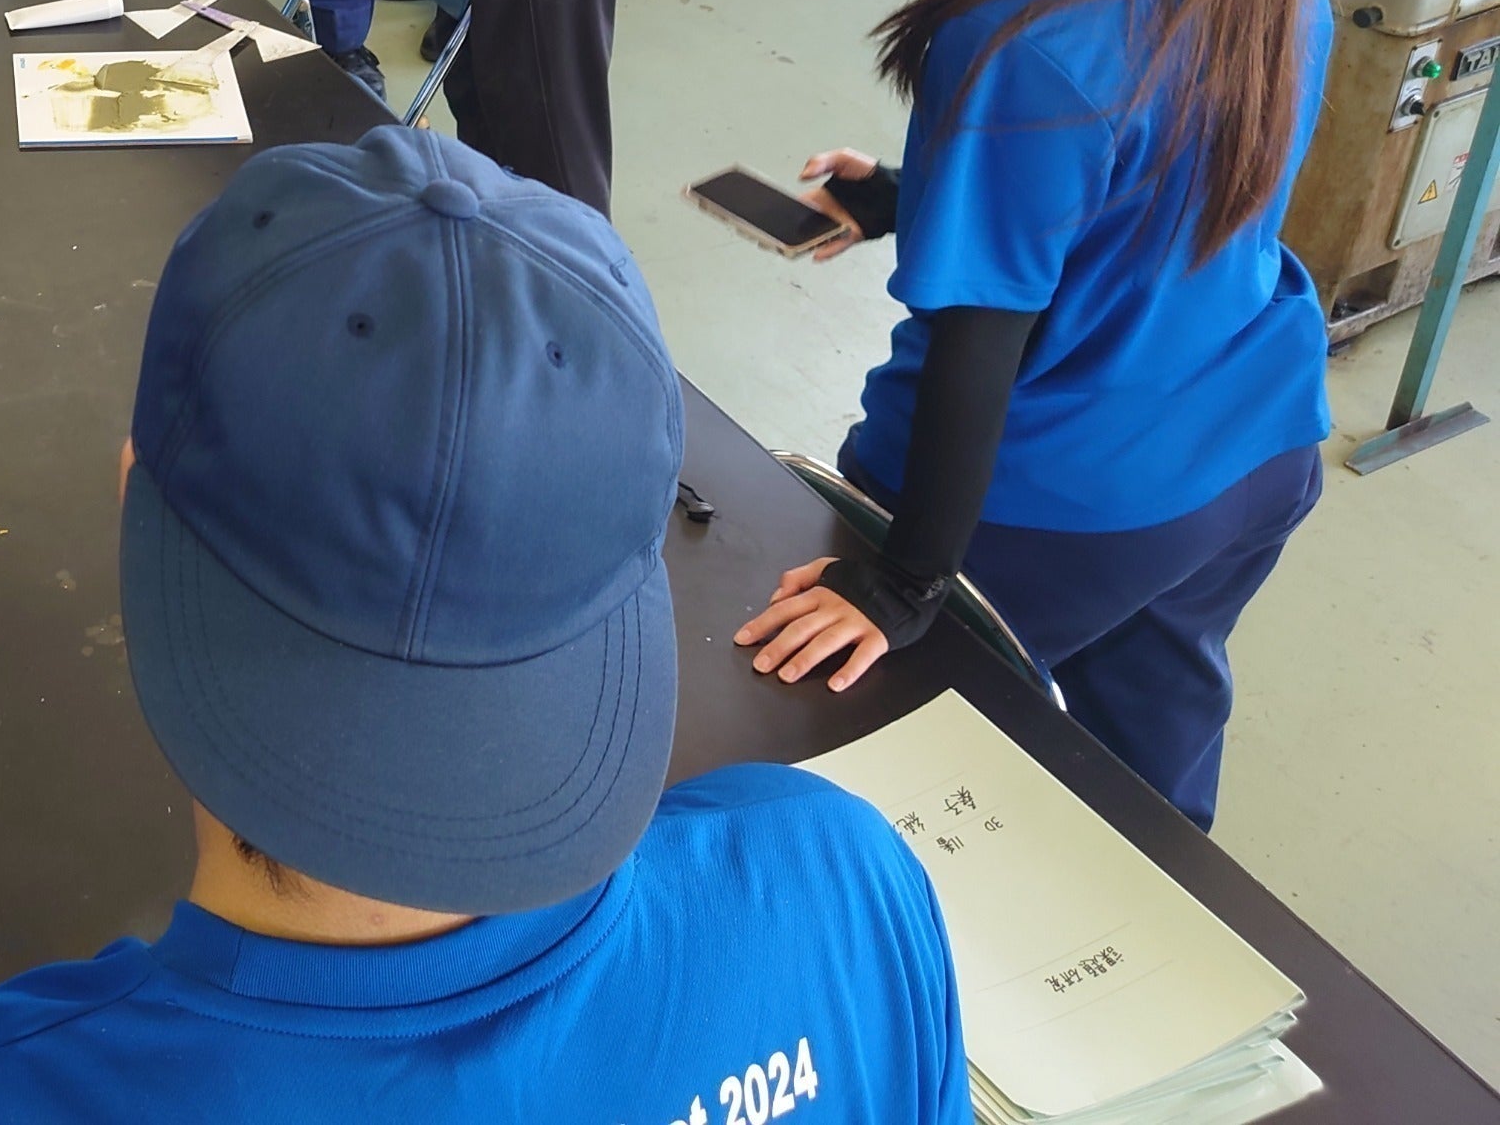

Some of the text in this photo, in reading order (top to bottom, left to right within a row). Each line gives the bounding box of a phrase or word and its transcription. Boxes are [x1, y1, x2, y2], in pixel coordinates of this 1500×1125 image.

[892, 811, 925, 836] 純
[1044, 946, 1124, 993] 課題研究
[719, 1037, 818, 1125] 2024
